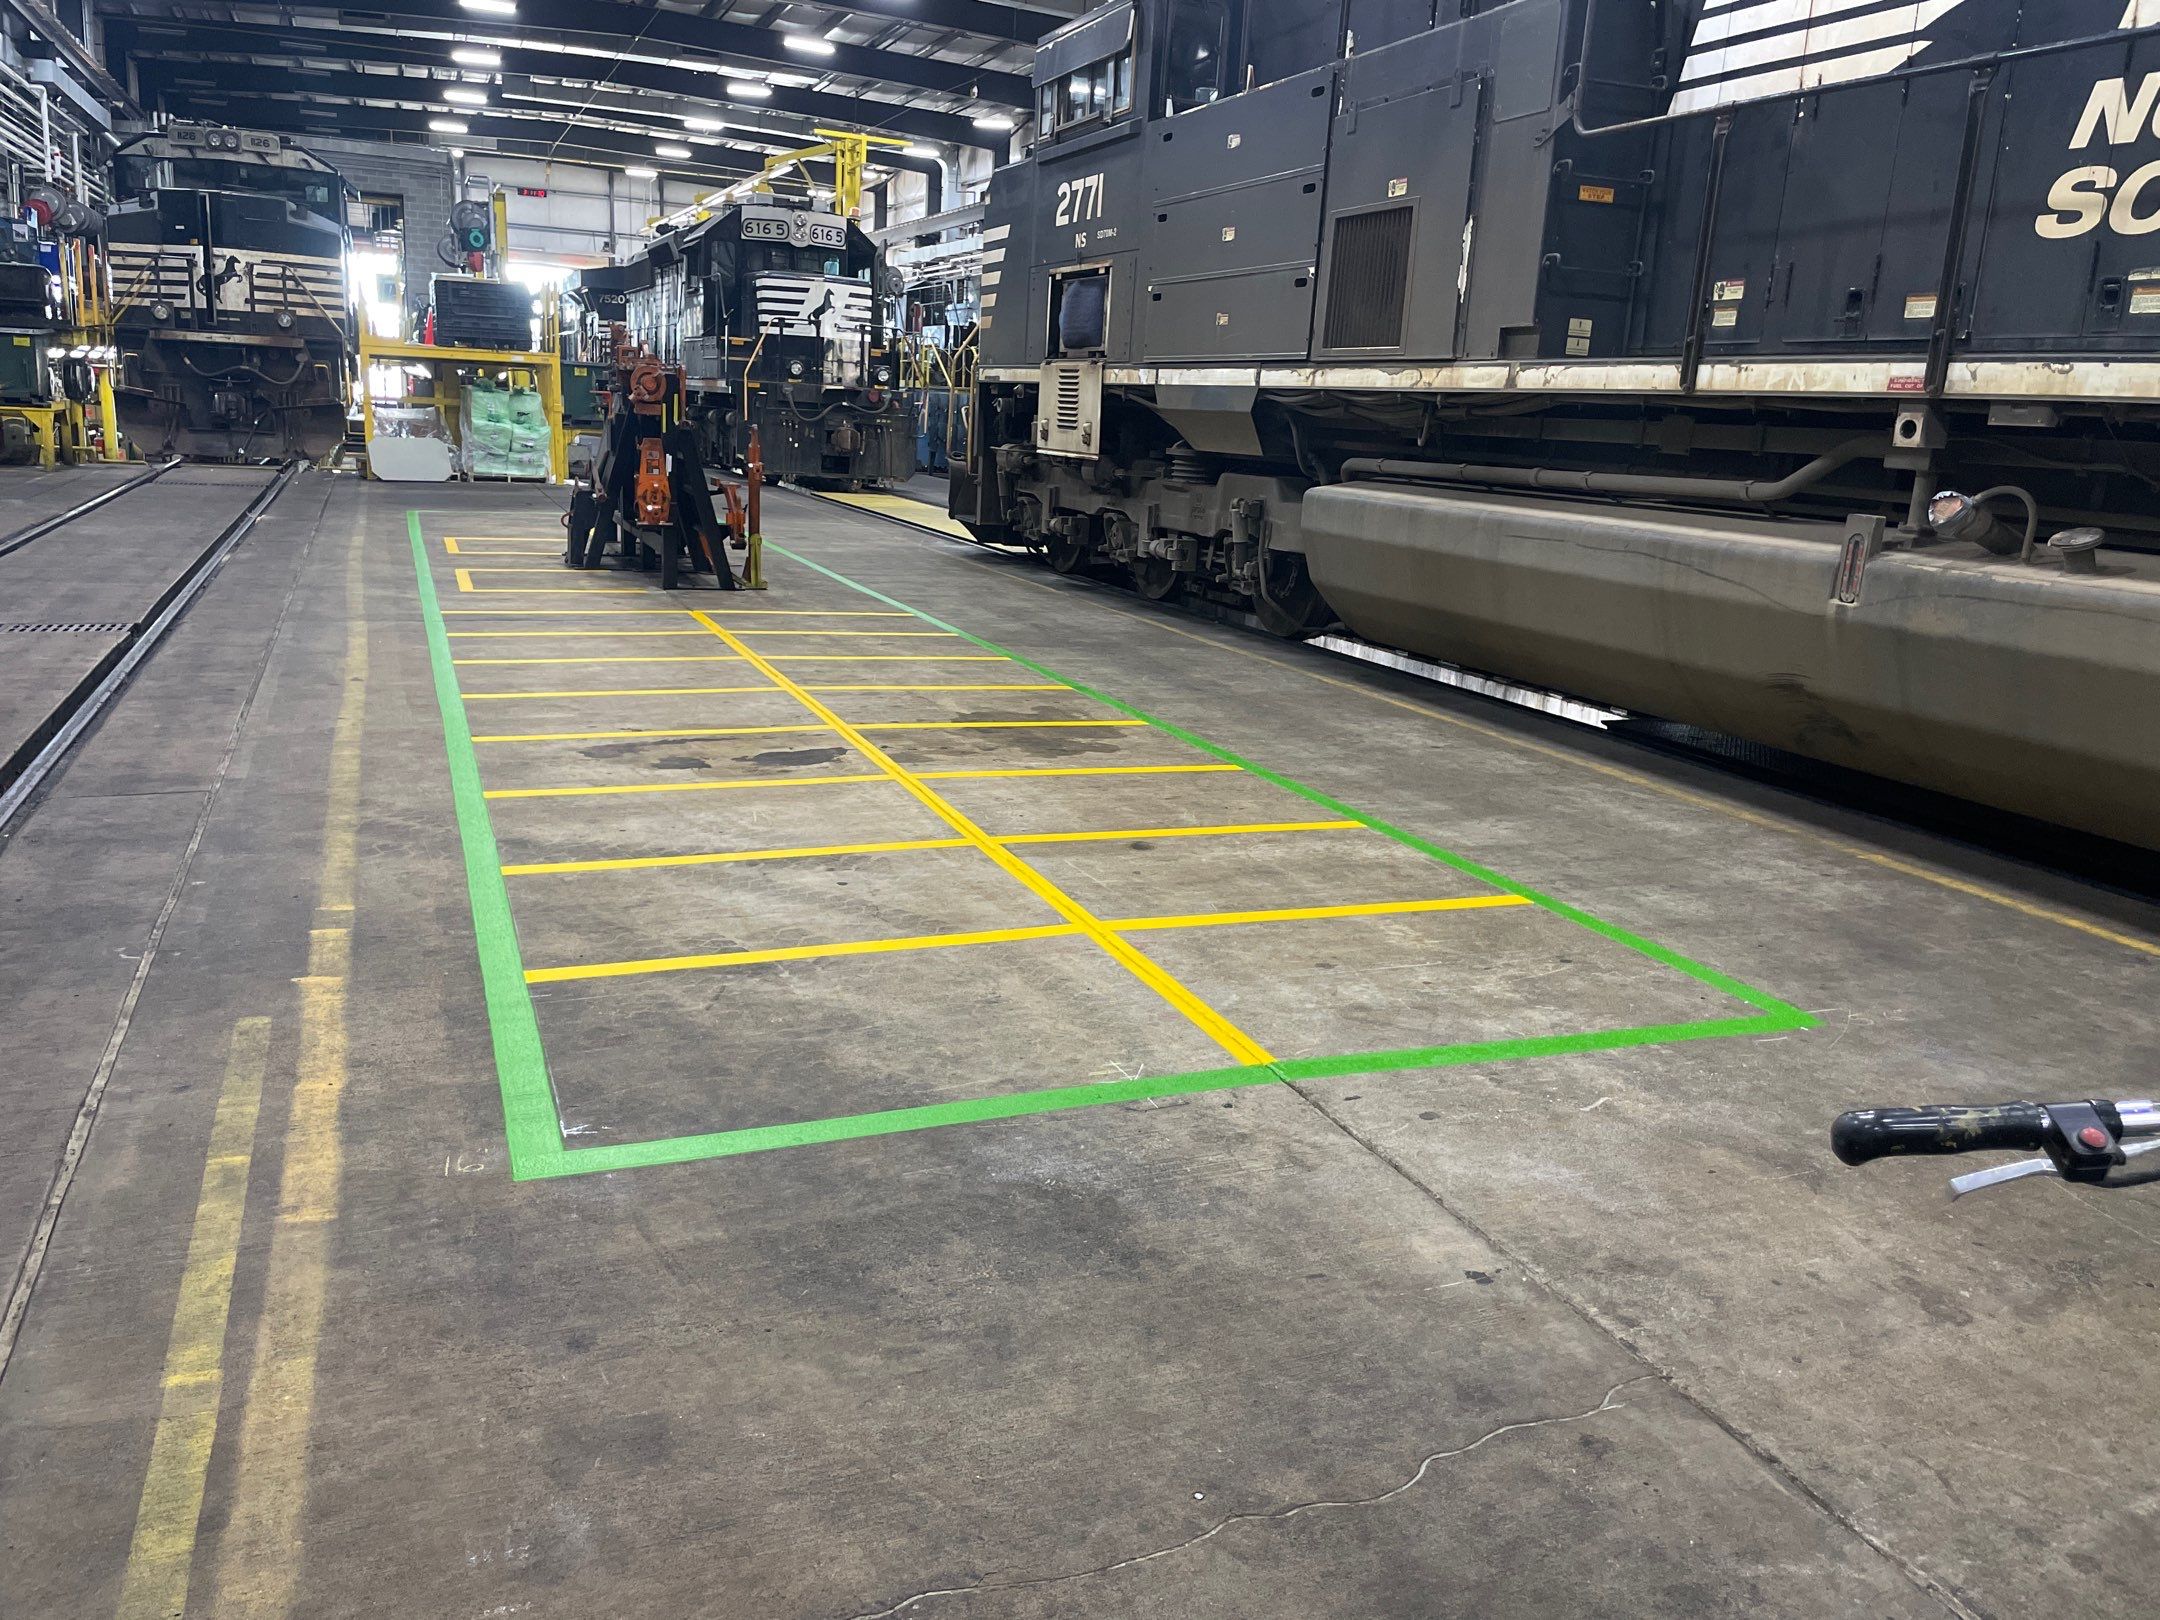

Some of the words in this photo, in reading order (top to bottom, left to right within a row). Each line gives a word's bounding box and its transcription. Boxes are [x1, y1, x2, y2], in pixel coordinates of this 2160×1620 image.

[1055, 172, 1104, 227] 2771
[744, 221, 785, 237] 6165
[811, 227, 844, 244] 6165
[1075, 231, 1087, 249] NS
[599, 294, 626, 305] 7520
